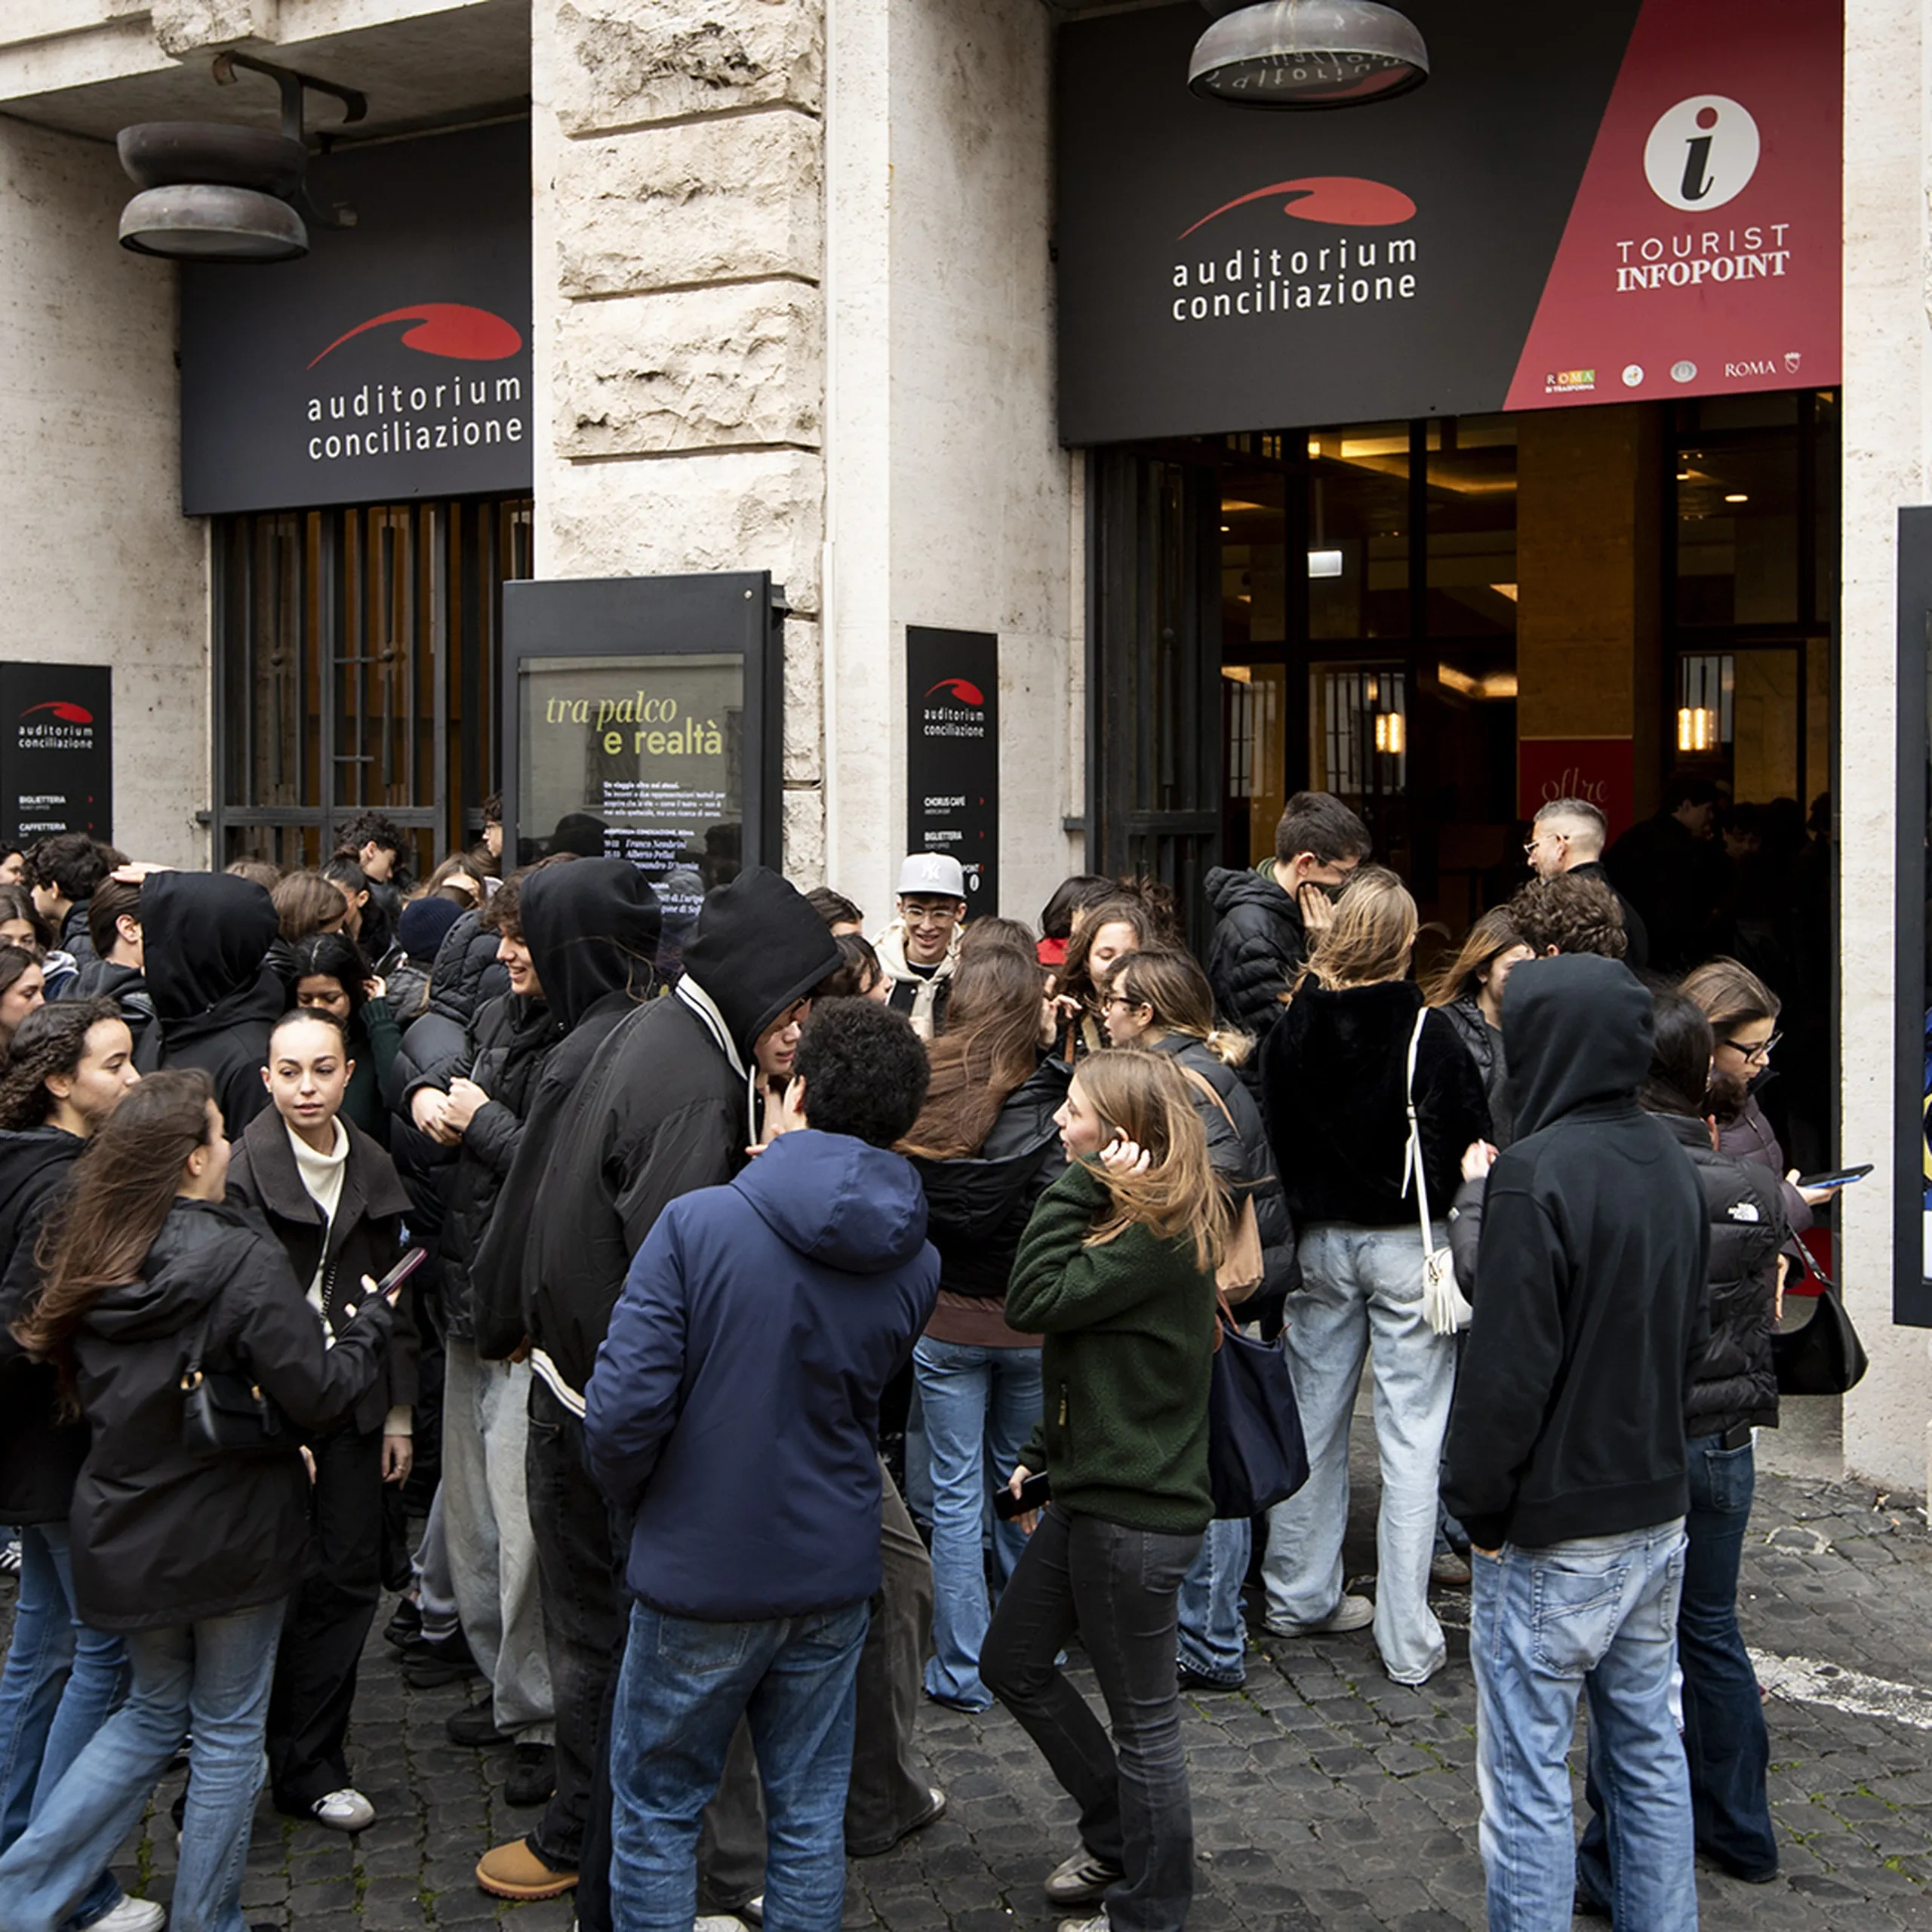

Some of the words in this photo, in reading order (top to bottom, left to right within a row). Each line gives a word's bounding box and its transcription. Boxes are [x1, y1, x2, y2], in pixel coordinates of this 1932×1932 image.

[1173, 238, 1417, 287] auditorium
[1617, 223, 1789, 263] TOURIST
[1617, 251, 1790, 292] INFOPOINT
[1172, 273, 1417, 321] conciliazione
[1546, 371, 1595, 385] ROMA
[1724, 360, 1777, 377] ROMA
[307, 375, 521, 421] auditorium
[308, 417, 522, 460] conciliazione
[19, 724, 93, 736] auditorium
[546, 697, 589, 724] tra
[596, 691, 677, 732] palco
[924, 708, 984, 721] auditorium
[924, 723, 984, 737] conciliazione
[19, 737, 93, 749] conciliazione
[603, 731, 623, 755] e
[634, 716, 722, 755] realtà
